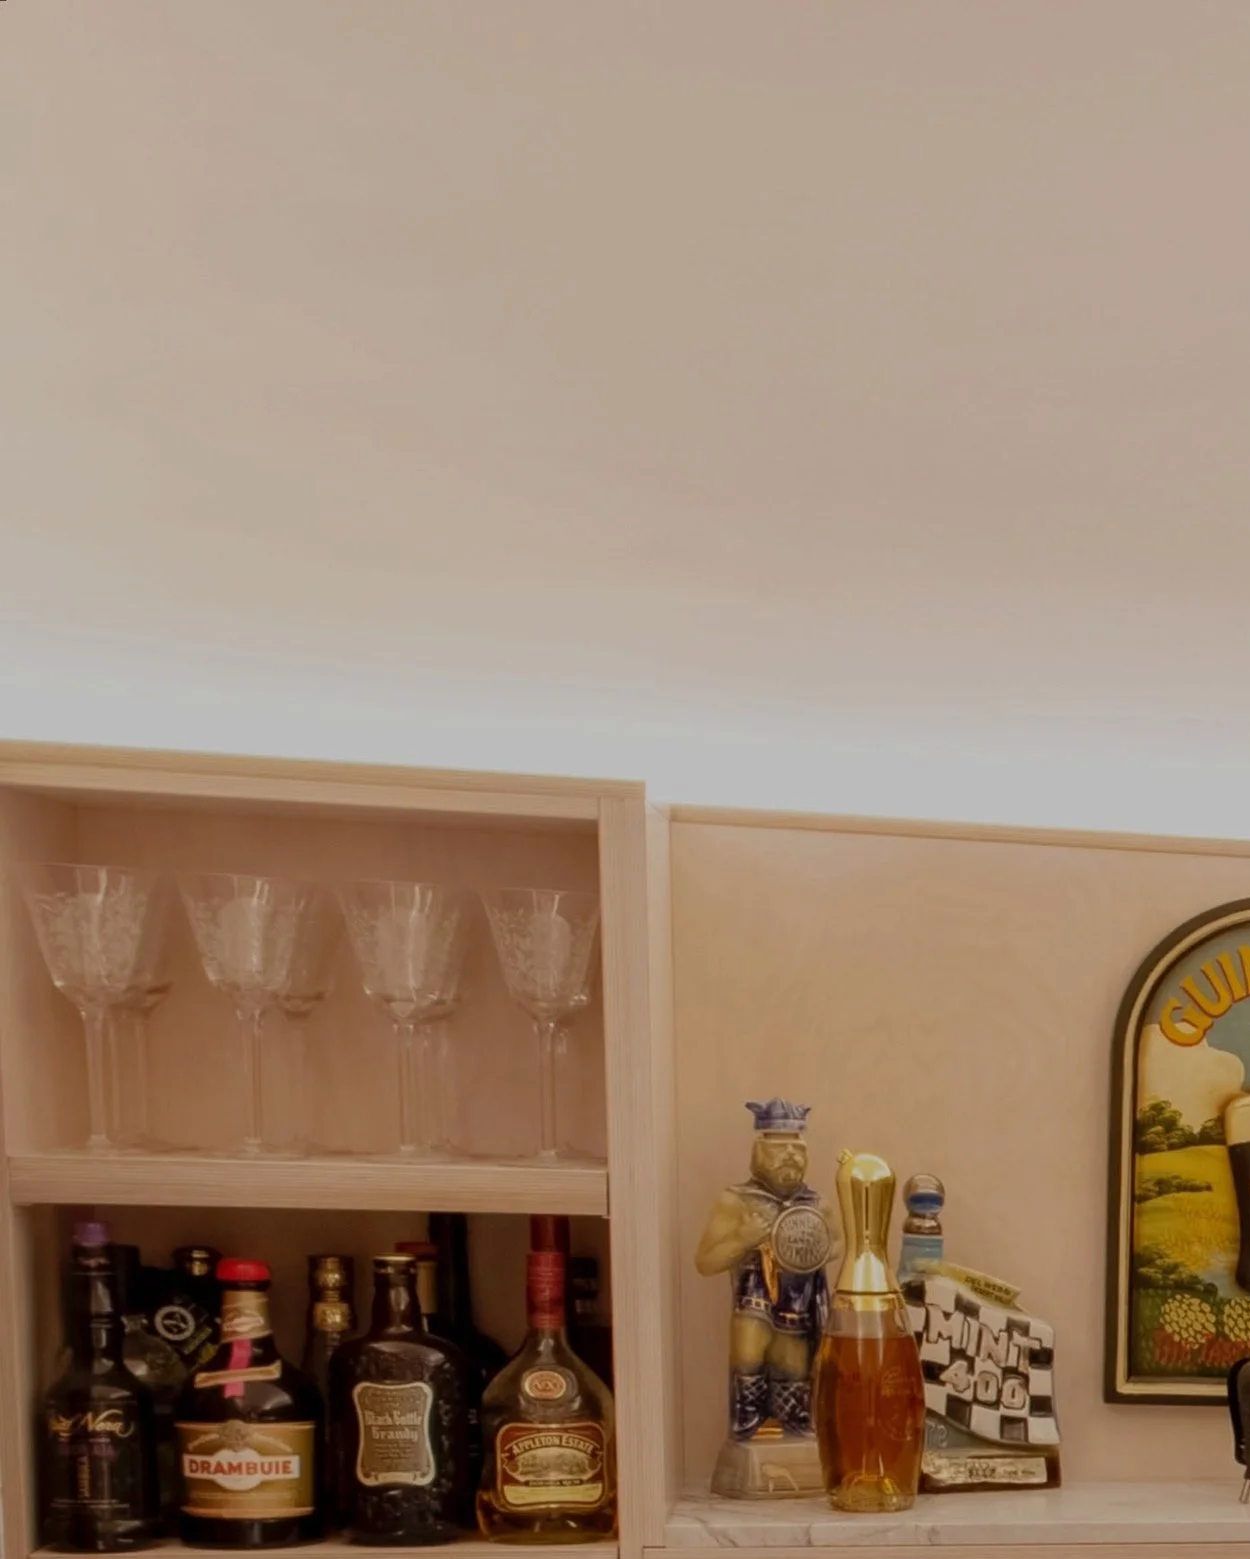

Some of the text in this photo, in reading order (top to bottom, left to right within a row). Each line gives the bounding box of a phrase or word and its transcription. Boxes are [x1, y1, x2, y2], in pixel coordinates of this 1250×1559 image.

[925, 1302, 1042, 1374] MINT
[939, 1357, 1027, 1411] 400
[511, 1435, 595, 1454] APPLETON ESTATE
[188, 1458, 293, 1476] DRAMBUIE
